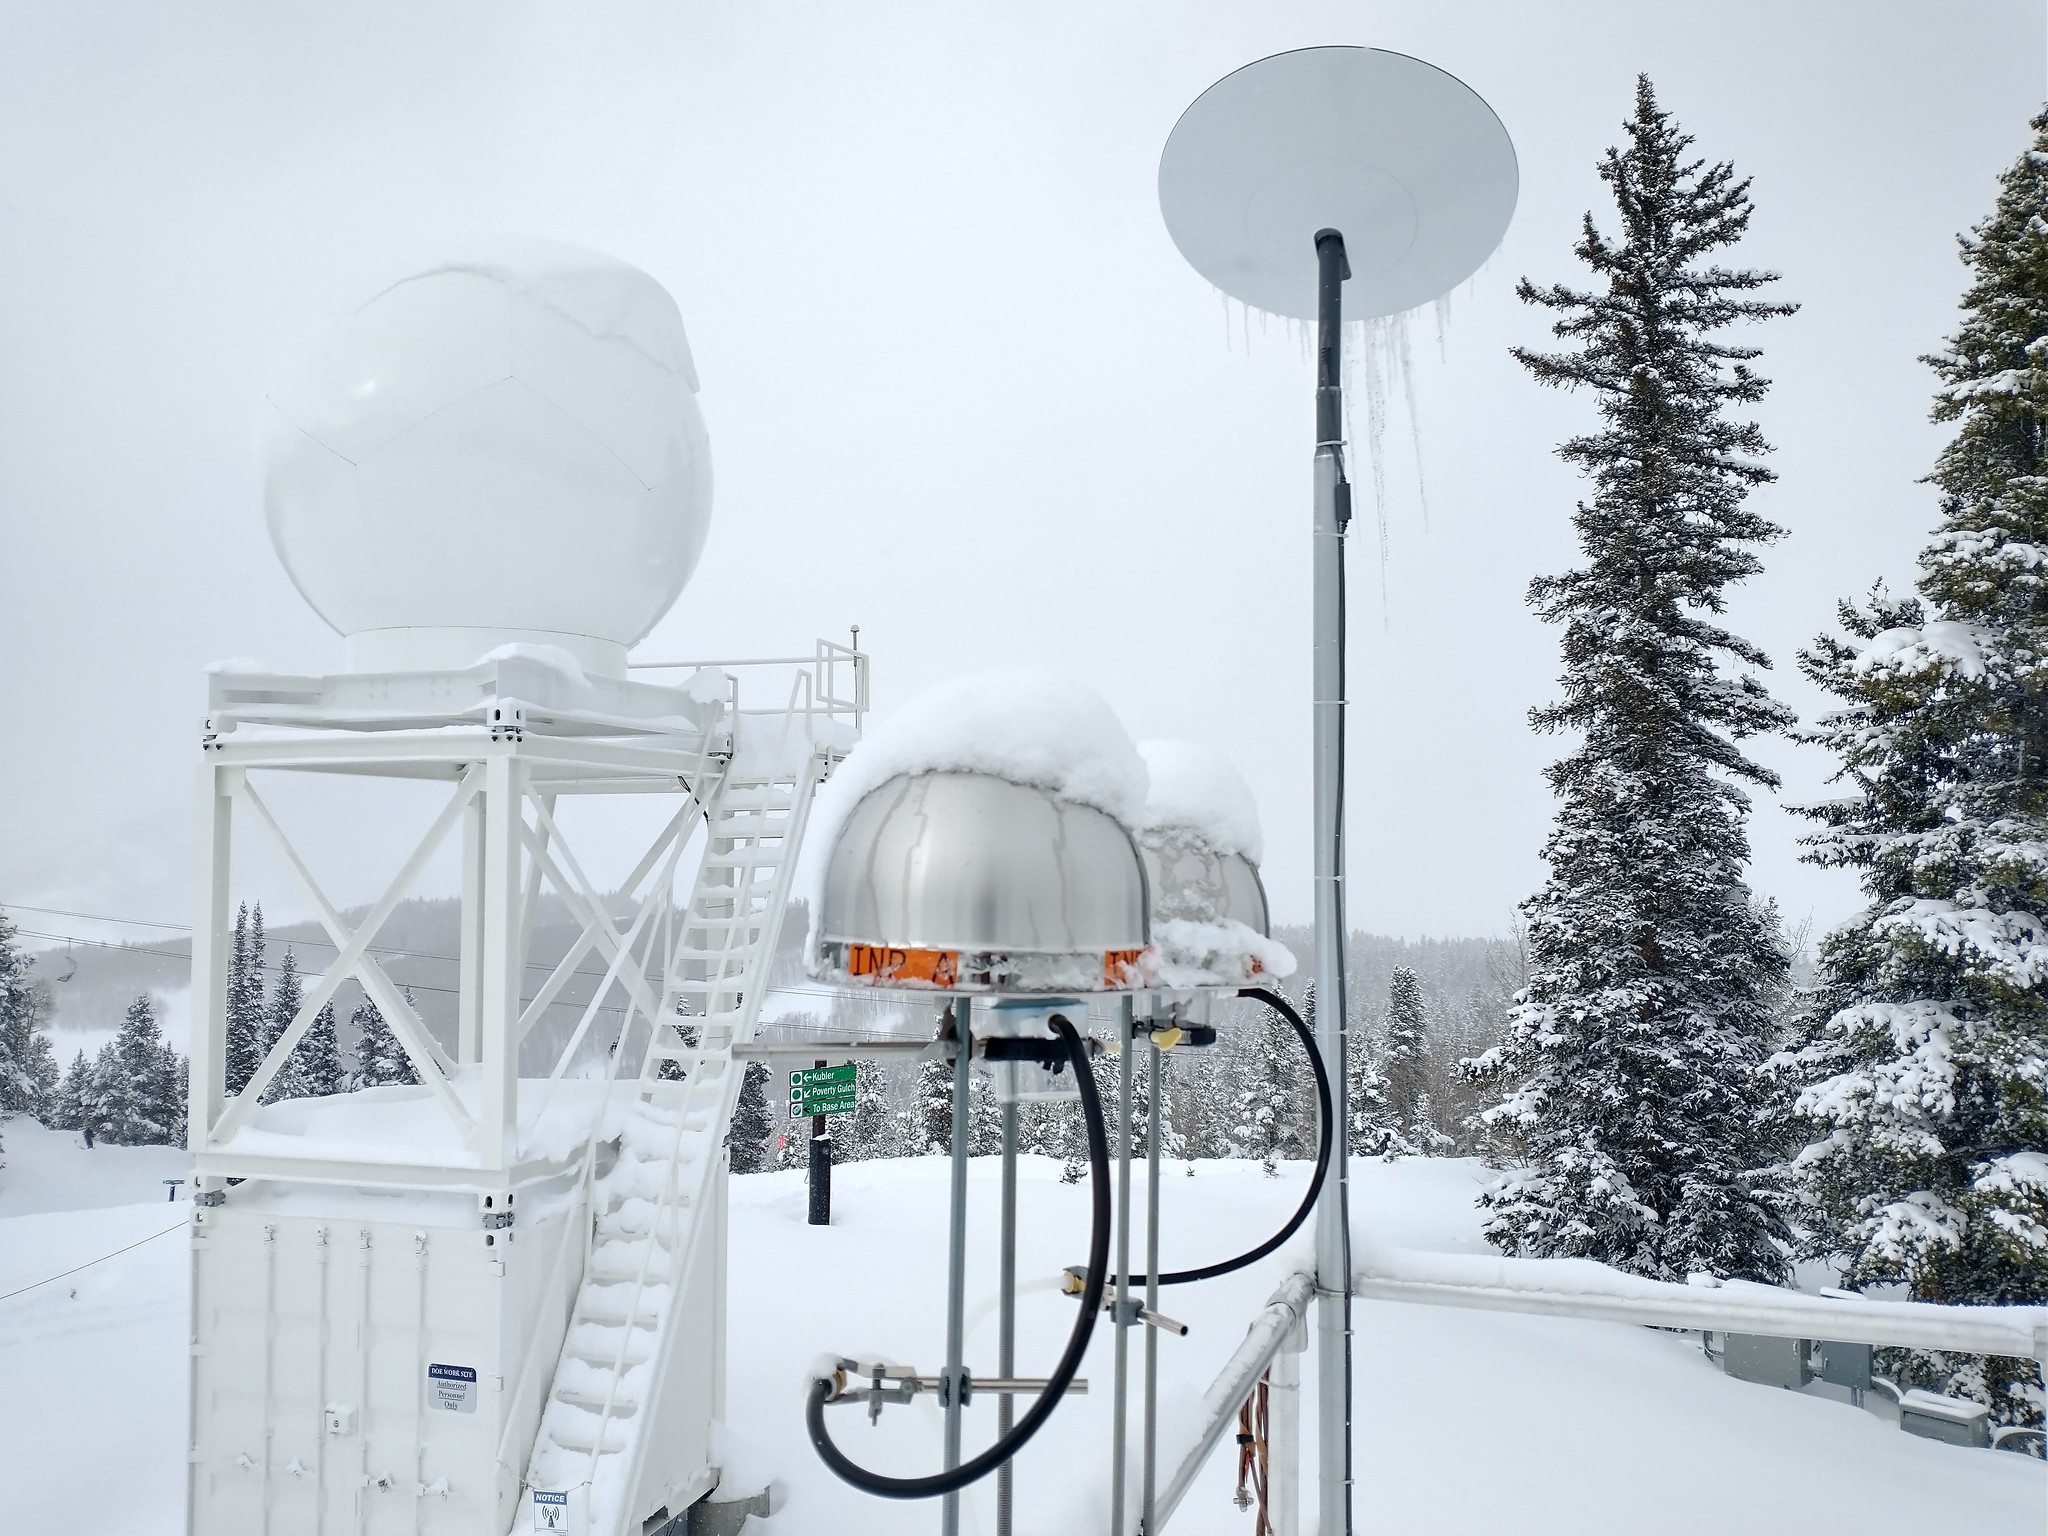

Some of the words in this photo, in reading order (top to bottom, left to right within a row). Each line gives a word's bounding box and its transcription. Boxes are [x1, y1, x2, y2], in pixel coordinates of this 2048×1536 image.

[812, 1071, 834, 1081] Kubler
[812, 1086, 837, 1096] Poverty
[837, 1083, 855, 1093] Gulch
[813, 1103, 821, 1113] To
[822, 1102, 838, 1111] Base
[839, 1100, 855, 1110] Area
[437, 1381, 466, 1390] Authorized
[438, 1390, 465, 1400] Personnel
[444, 1401, 458, 1410] Only
[536, 1493, 565, 1502] NOTICE
